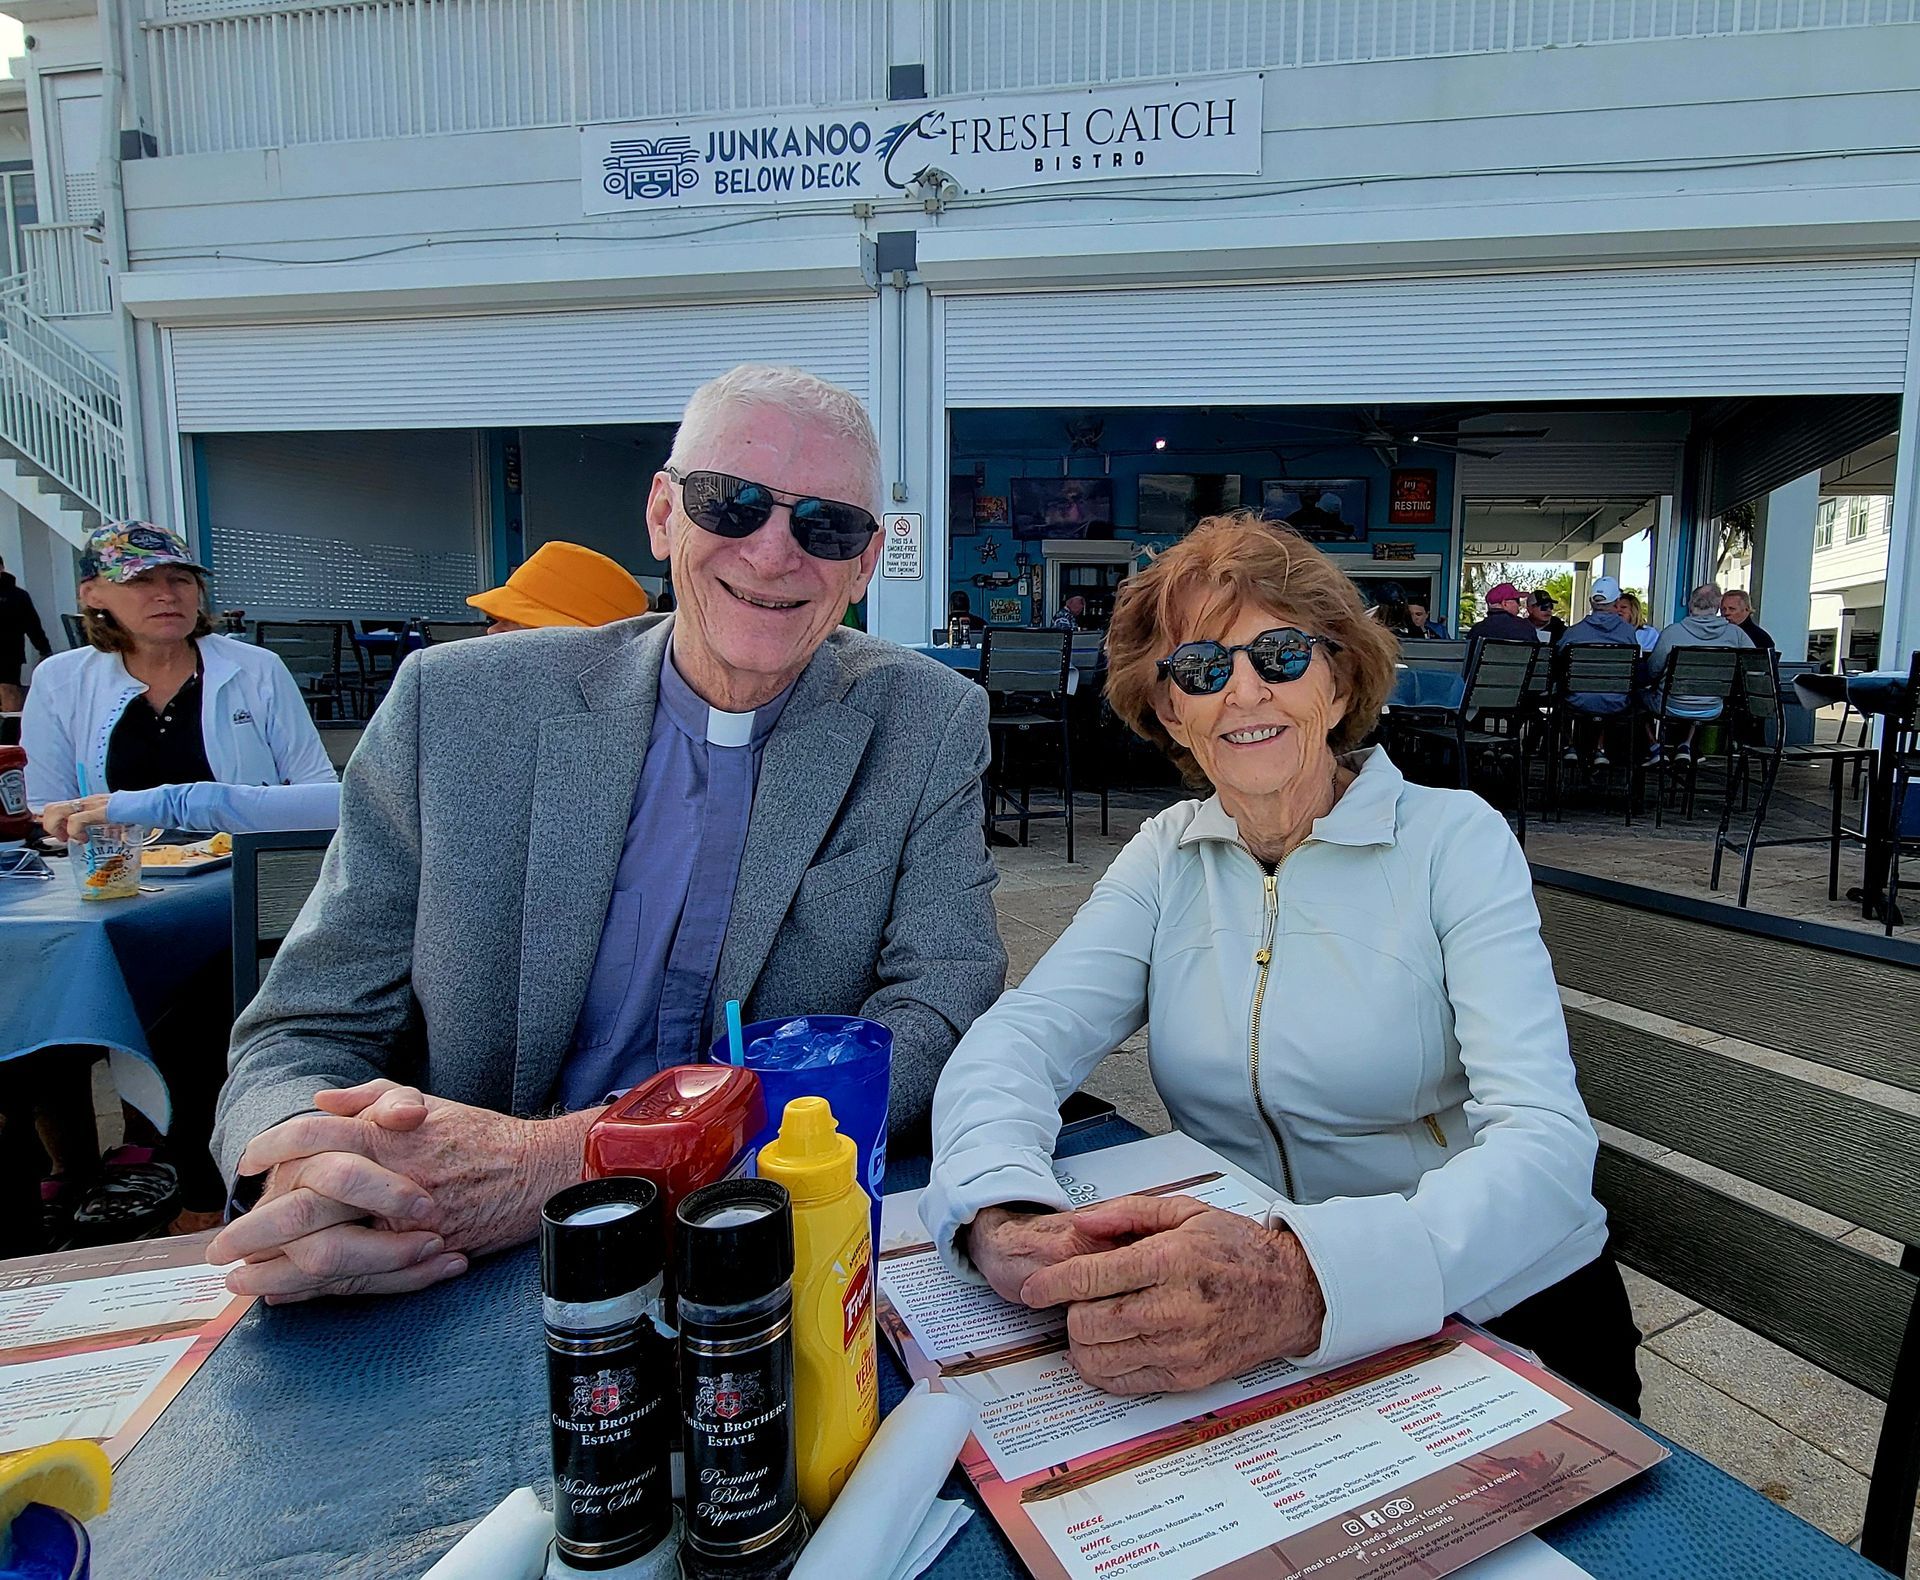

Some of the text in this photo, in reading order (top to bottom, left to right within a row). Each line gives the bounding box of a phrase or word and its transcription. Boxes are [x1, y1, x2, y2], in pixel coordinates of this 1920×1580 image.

[950, 98, 1236, 156] FRESH CATCH
[705, 121, 871, 163] JUNKANOO
[1034, 152, 1146, 173] BISTRO
[715, 161, 861, 195] BELOW DECK
[1395, 501, 1431, 510] RESTING
[992, 599, 1003, 607] NO
[884, 1261, 915, 1270] MARINA
[890, 1270, 926, 1281] GROUPER
[906, 1290, 959, 1304] CAULIFLOWER
[915, 1301, 980, 1319] FRIED CALAMARI
[926, 1323, 960, 1334] COASTAL
[963, 1314, 998, 1326] COCONUT
[933, 1320, 1028, 1346] PARMESAN TRUFFLE FRIES
[1040, 1371, 1057, 1380] ADD
[980, 1385, 1083, 1419] HIGH TIDE HOUSE SALAD
[984, 1395, 1009, 1406] Chicken
[1377, 1384, 1442, 1415] BUFFALO CHICKEN
[552, 1398, 662, 1432] CHENEY BROTHERS
[683, 1400, 787, 1433] CHENEY BROTHERS
[993, 1399, 1105, 1439] CAPTAIN'S CAESAR SALAD
[1401, 1409, 1443, 1433] MEATLOVER
[581, 1428, 631, 1445] ESTATE
[707, 1433, 755, 1446] ESTATE
[1426, 1426, 1473, 1452] MAMMA MIA
[1134, 1466, 1157, 1479] HAND
[1158, 1457, 1186, 1471] TOSSED
[1235, 1449, 1278, 1470] HAWAIIAN
[557, 1465, 657, 1497] Mediterranean
[700, 1466, 769, 1485] Premium
[1250, 1467, 1282, 1487] VEGGIE
[1257, 1475, 1294, 1492] Mushroom,
[1293, 1467, 1315, 1478] Onion,
[1315, 1458, 1333, 1469] Green
[1280, 1497, 1316, 1515] Pepperoni,
[1344, 1477, 1365, 1488] Onion,
[1364, 1464, 1398, 1480] Mushroom,
[1398, 1454, 1416, 1466] Green
[571, 1488, 643, 1515] Sea Salt
[710, 1484, 760, 1504] Black
[1273, 1489, 1306, 1509] WORKS
[697, 1495, 777, 1527] Peppercorns
[1071, 1494, 1185, 1542] Tomato Sauce, Mozzarella. 13.99
[1286, 1509, 1313, 1522] Pepper,
[1313, 1499, 1329, 1511] Black
[1303, 1560, 1324, 1575] meal
[1326, 1555, 1337, 1564] on
[1338, 1542, 1361, 1559] social
[1362, 1532, 1387, 1546] media
[1388, 1524, 1403, 1535] and
[1404, 1514, 1425, 1527] don't
[1424, 1502, 1448, 1517] forget
[1458, 1488, 1478, 1501] leave
[1478, 1484, 1488, 1492] us
[1494, 1469, 1520, 1484] review!
[1066, 1515, 1104, 1535] CHEESE
[1086, 1503, 1225, 1561] Garlic, EVOO, Ricotta, Mozzarella. 15.99
[1387, 1529, 1424, 1551] Junkanoo
[1423, 1516, 1454, 1533] favorite
[1080, 1536, 1112, 1553] WHITE
[1128, 1556, 1159, 1570] Tomato,
[1160, 1546, 1179, 1557] Basil,
[1180, 1531, 1218, 1549] Mozzarella.
[1218, 1520, 1239, 1533] 15.99
[1094, 1541, 1160, 1574] MARGHERITA
